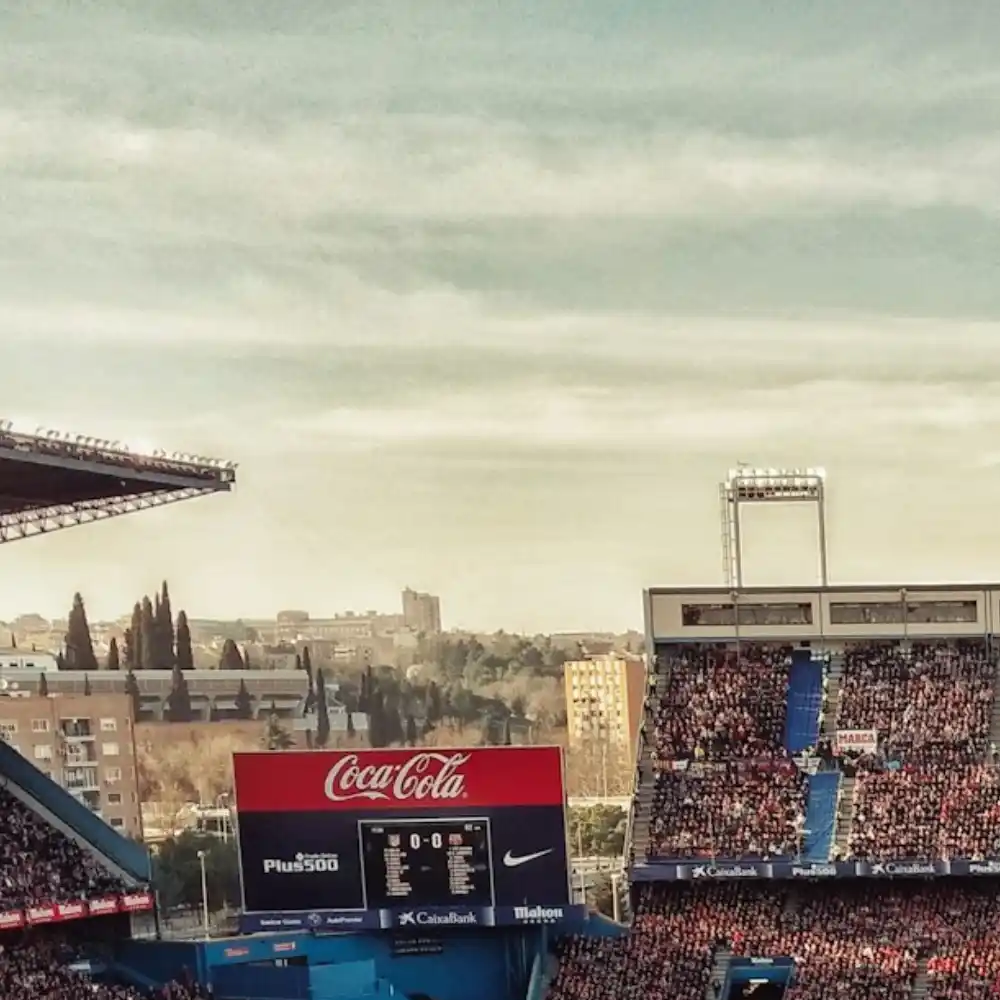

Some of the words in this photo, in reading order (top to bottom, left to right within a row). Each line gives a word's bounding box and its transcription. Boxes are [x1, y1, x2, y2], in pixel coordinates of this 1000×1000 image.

[839, 733, 875, 744] MARCA
[325, 752, 472, 801] Coca-Cola
[263, 859, 339, 873] Plus500
[706, 865, 758, 877] CaixaBank
[885, 862, 935, 874] CaixaBank
[416, 911, 476, 924] CaixaBank
[514, 905, 564, 919] Mahou
